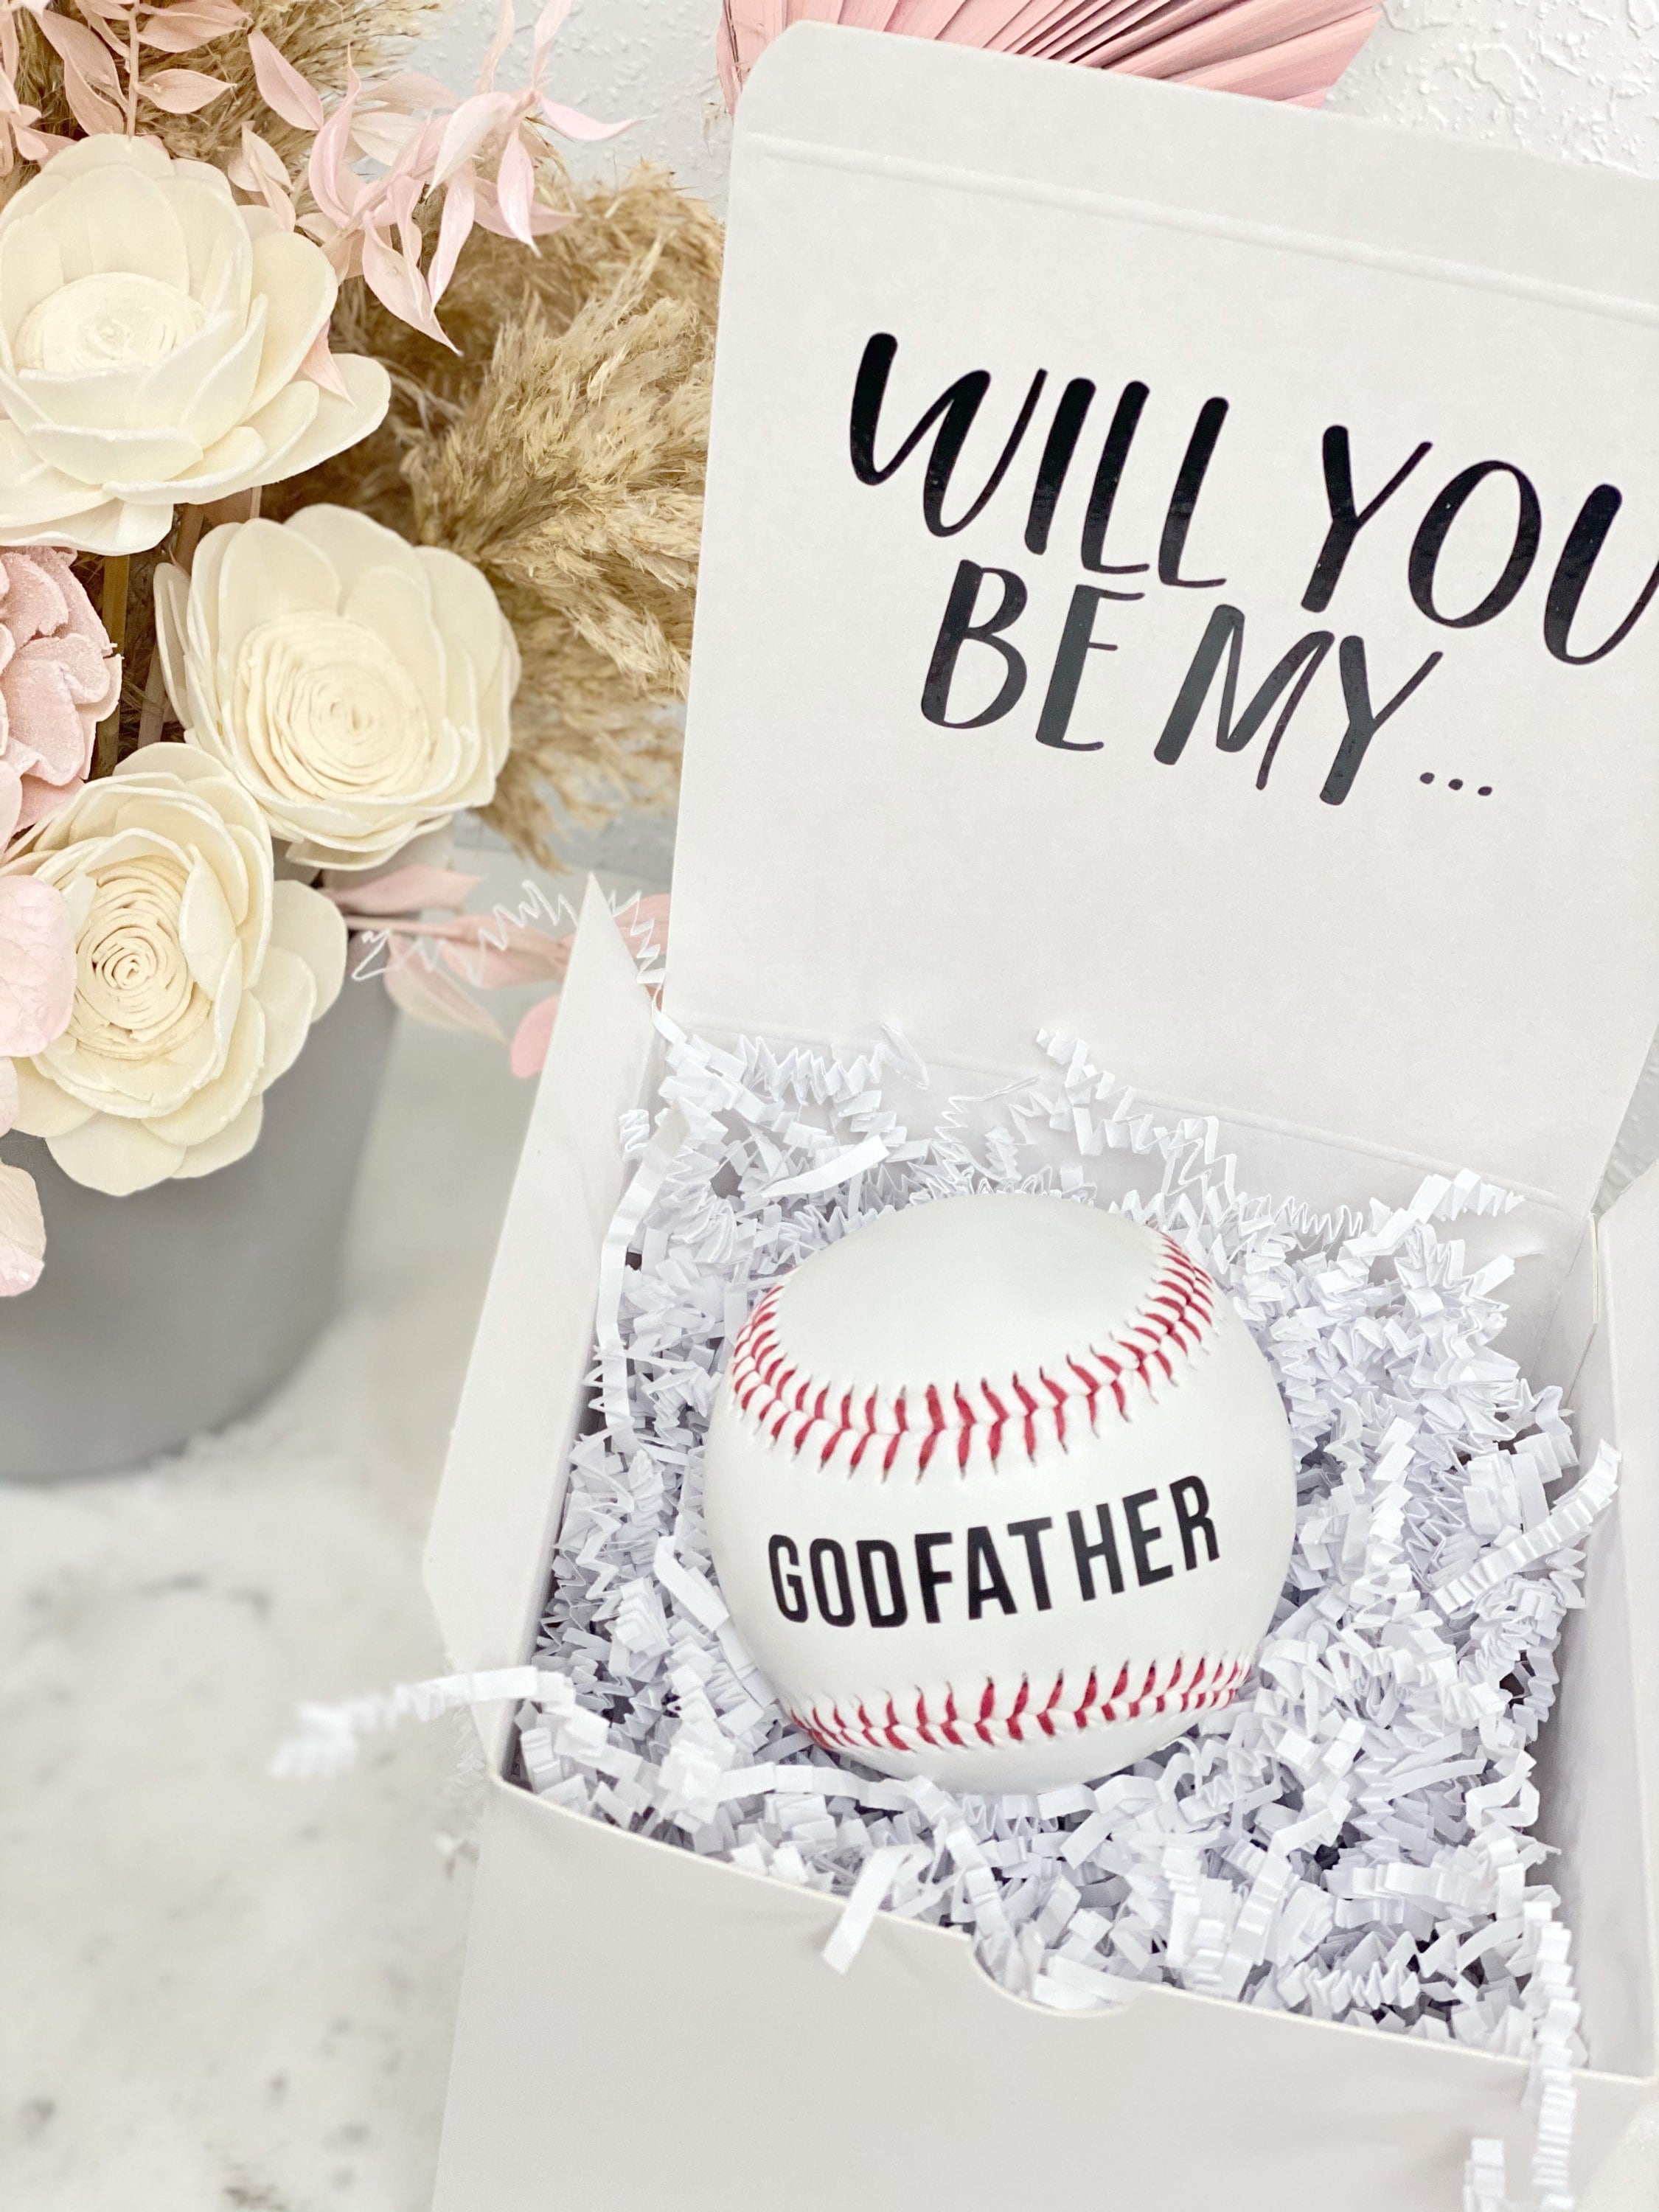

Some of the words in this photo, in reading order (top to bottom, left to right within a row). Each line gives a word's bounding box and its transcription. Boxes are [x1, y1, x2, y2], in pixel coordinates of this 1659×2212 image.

[849, 333, 1229, 588] WILL
[1301, 425, 1659, 665] YOU
[920, 559, 1145, 751] BE
[1153, 604, 1493, 806] MY...
[768, 1475, 1220, 1628] GODFATHER
